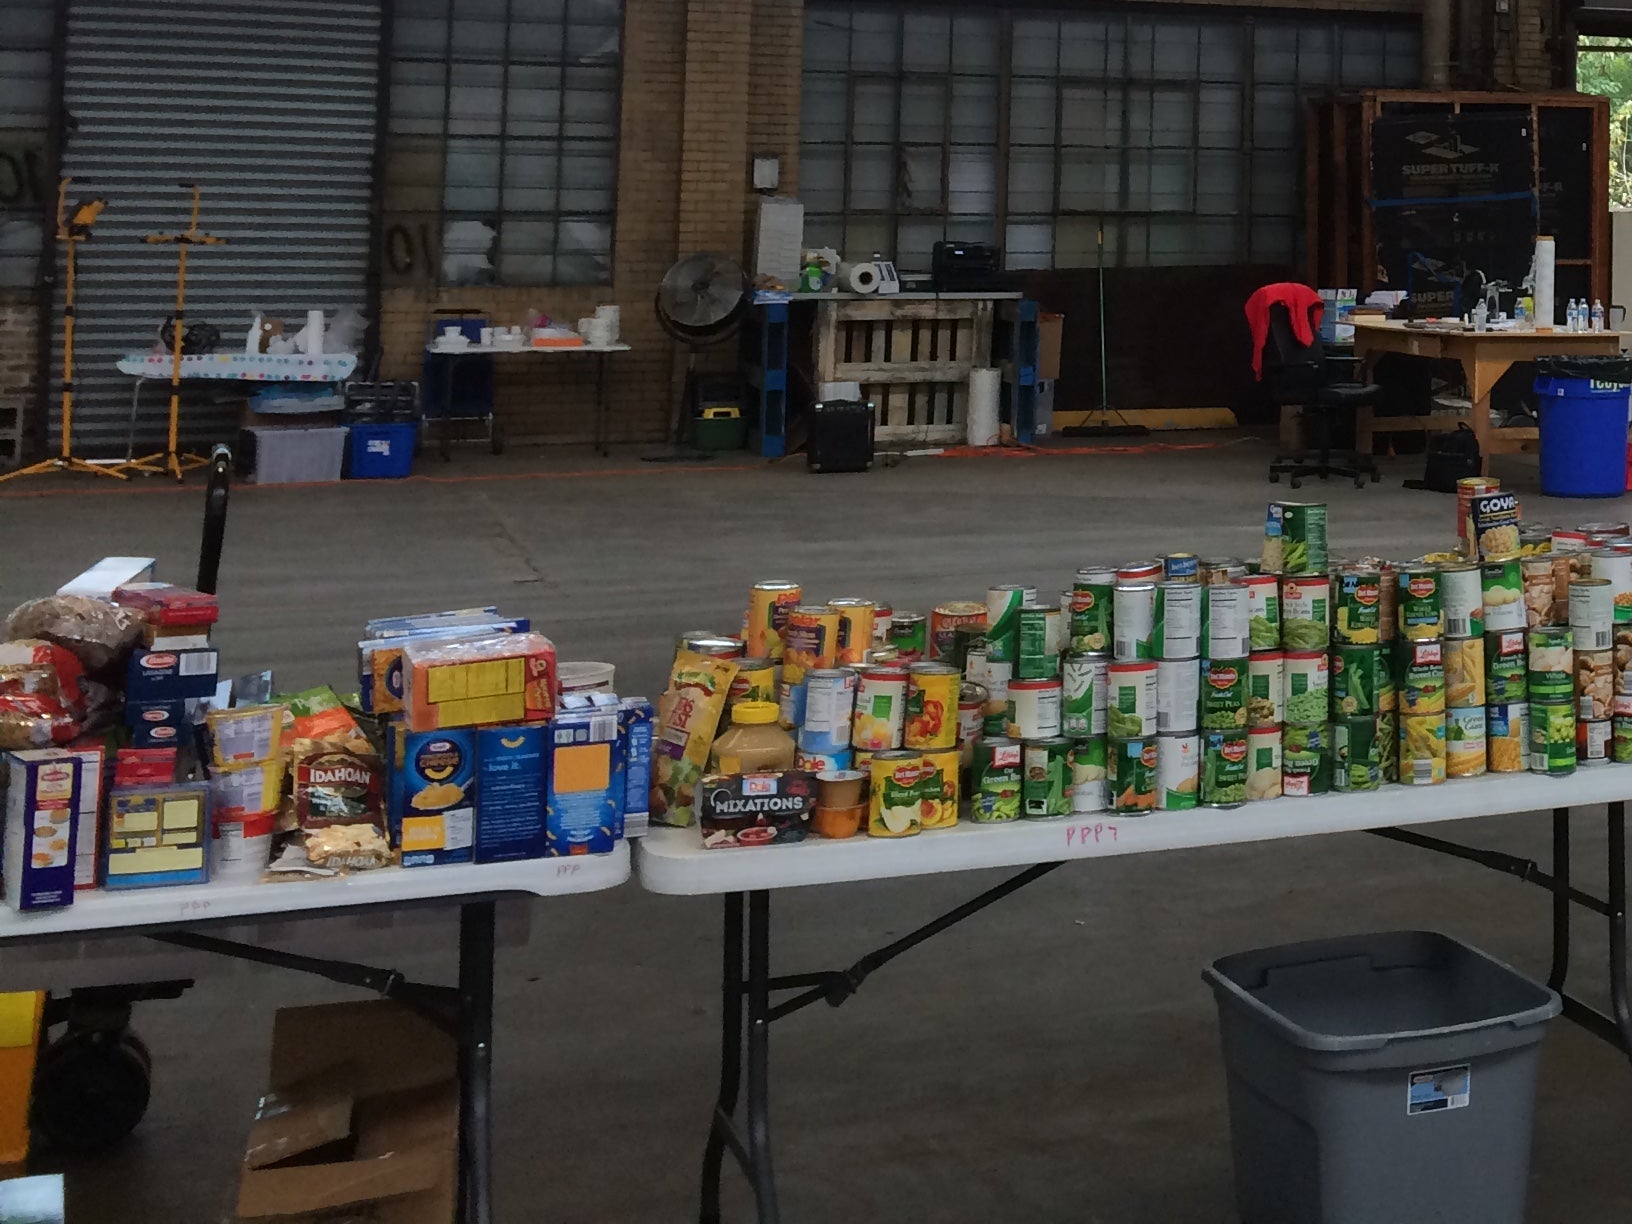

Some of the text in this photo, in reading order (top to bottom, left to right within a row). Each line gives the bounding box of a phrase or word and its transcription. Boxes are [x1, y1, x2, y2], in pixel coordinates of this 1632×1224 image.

[1401, 164, 1450, 174] SUPER
[1410, 291, 1454, 302] SUPER
[1480, 496, 1516, 513] GOYA
[797, 753, 826, 770] Dole
[310, 768, 372, 785] IDAHOAN
[716, 796, 804, 814] MIXATIONS
